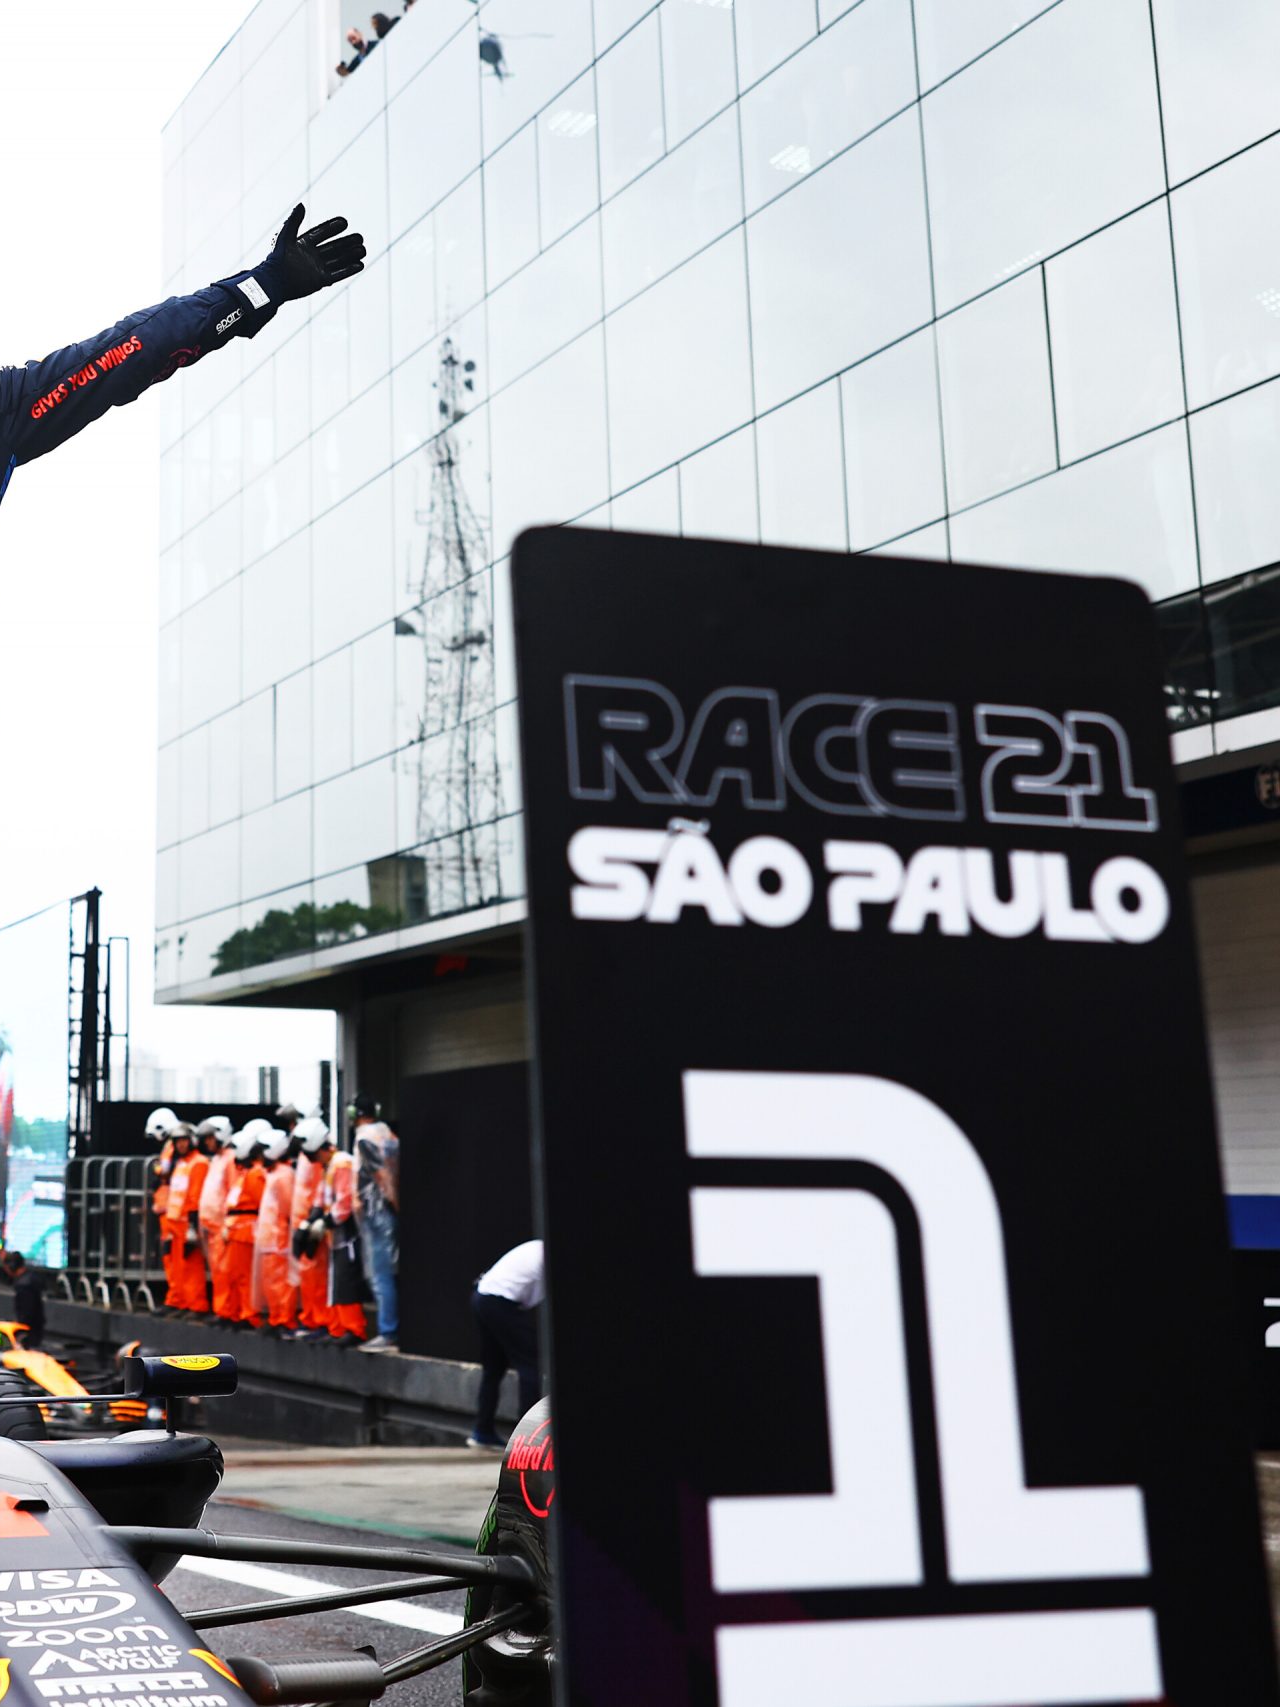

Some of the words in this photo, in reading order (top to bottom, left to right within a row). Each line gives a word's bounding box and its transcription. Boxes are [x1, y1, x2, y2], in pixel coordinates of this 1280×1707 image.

[216, 307, 243, 333] sparc
[31, 383, 68, 419] GIVES
[67, 363, 98, 391] YOU
[95, 335, 142, 371] WINGS
[564, 673, 966, 821] RACE
[975, 704, 1159, 832] 21
[567, 816, 815, 928] SÃO
[823, 839, 1171, 945] PAULO
[681, 1068, 1152, 1594] 1
[507, 1434, 550, 1471] Hard
[0, 1624, 170, 1648] zoom
[80, 1644, 183, 1660] ARCTIC
[97, 1656, 179, 1671] WOLF
[33, 1671, 210, 1697] PIRELLI
